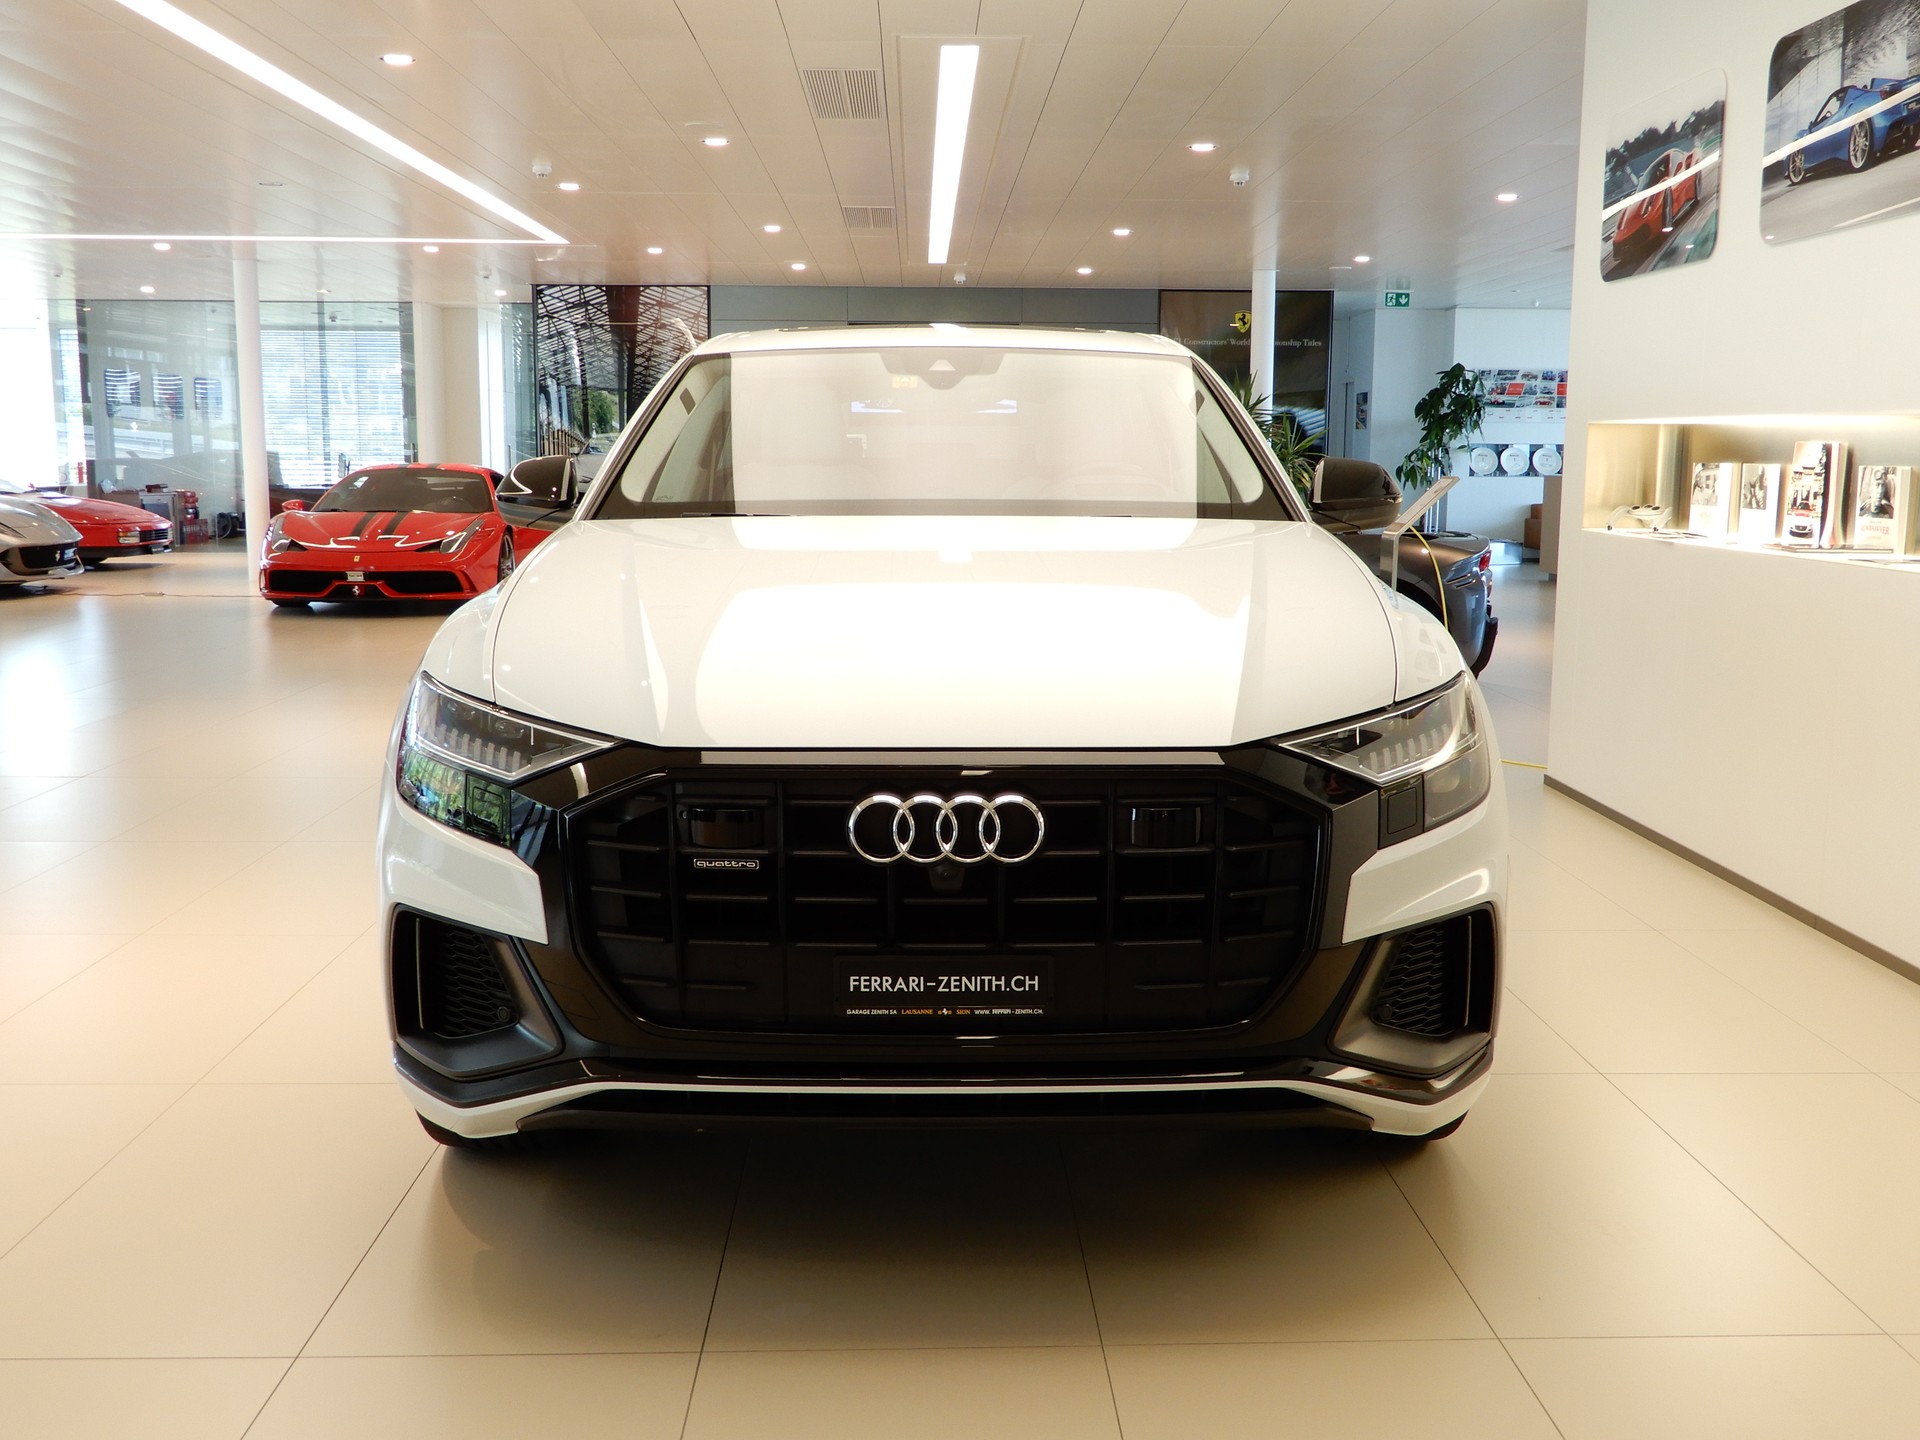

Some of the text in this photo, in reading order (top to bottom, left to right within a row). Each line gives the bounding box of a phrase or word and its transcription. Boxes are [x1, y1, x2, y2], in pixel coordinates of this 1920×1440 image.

[1183, 337, 1229, 346] Constructors'
[1229, 338, 1251, 346] World
[1302, 338, 1322, 347] Titles
[696, 860, 756, 868] quattro
[849, 975, 1039, 992] FERRARI-ZENITH.CH
